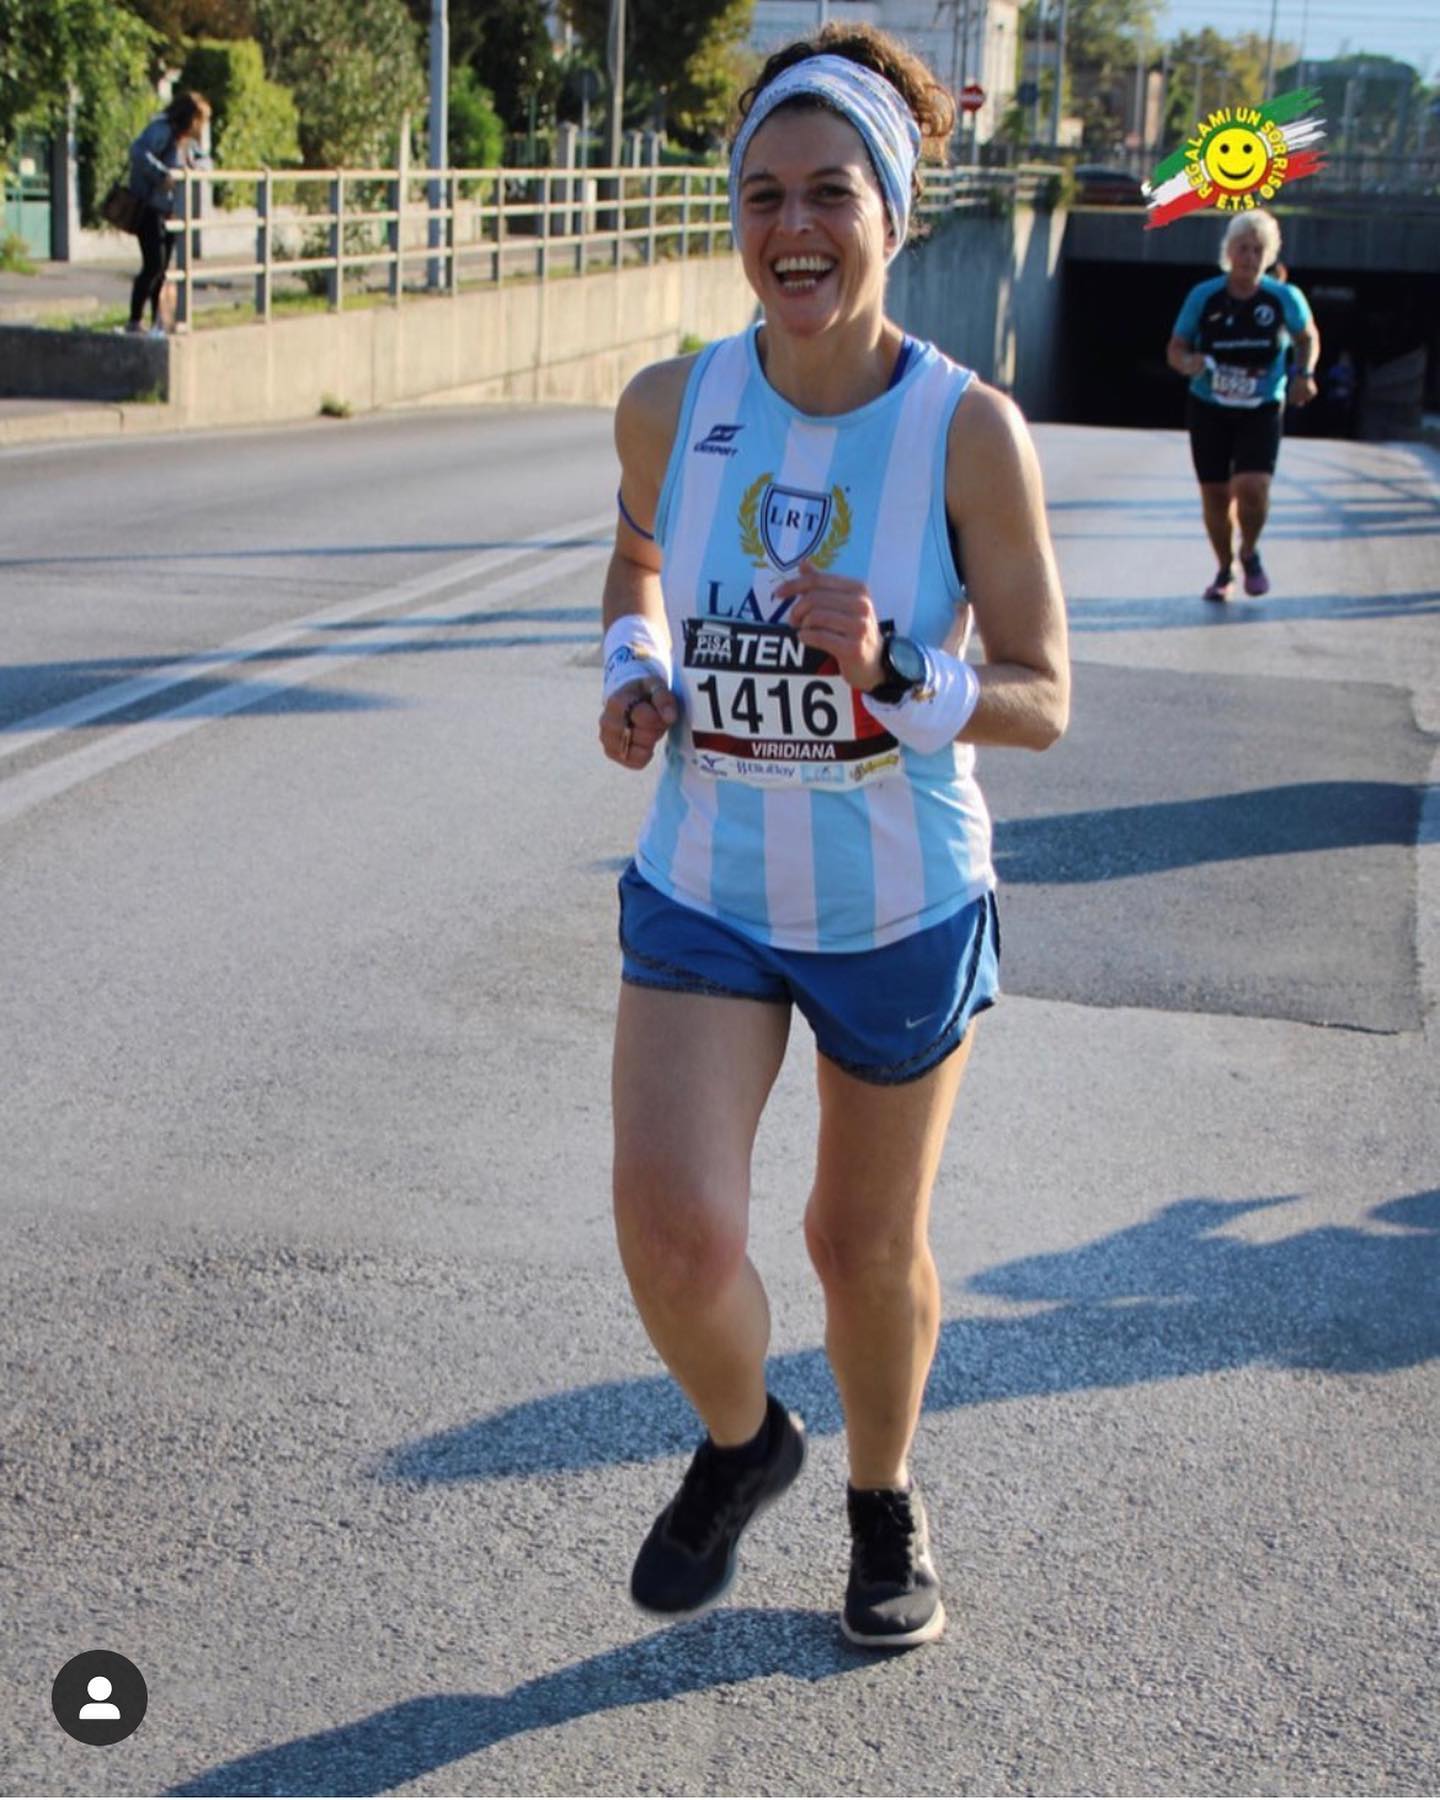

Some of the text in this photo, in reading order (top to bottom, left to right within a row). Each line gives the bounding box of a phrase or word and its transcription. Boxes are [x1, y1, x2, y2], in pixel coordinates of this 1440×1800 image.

[736, 633, 805, 667] TEN
[697, 674, 838, 738] 1416
[751, 741, 836, 759] VIRIDIANA
